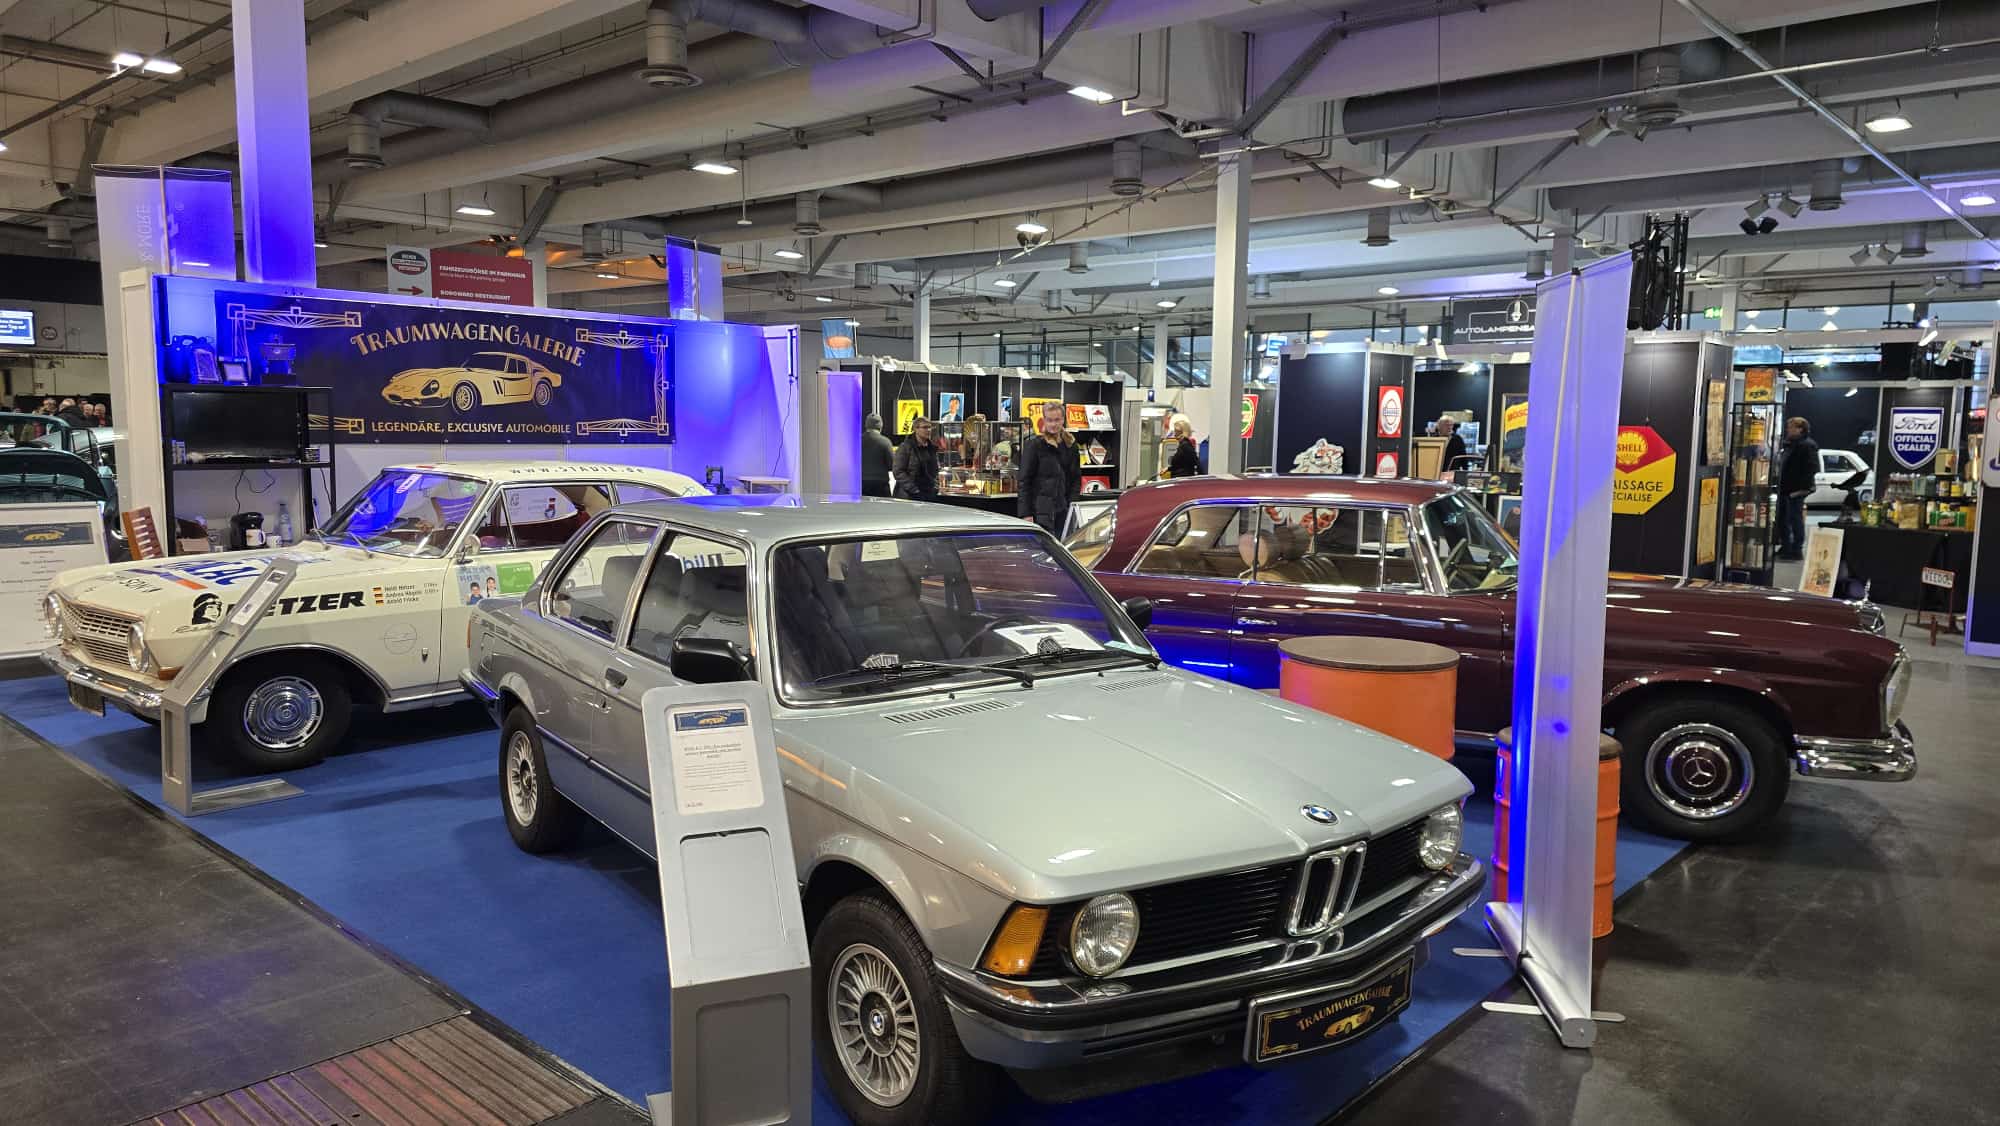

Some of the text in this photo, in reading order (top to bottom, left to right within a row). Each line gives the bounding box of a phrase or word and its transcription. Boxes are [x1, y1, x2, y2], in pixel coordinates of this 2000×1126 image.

[371, 420, 571, 434] LEGENDÄRE, EXCLUSIVE AUTOMOBILE
[1895, 416, 1936, 431] Ford
[1894, 434, 1935, 443] OFFICIAL
[1616, 443, 1642, 453] SHELL
[1897, 443, 1931, 452] DEALER
